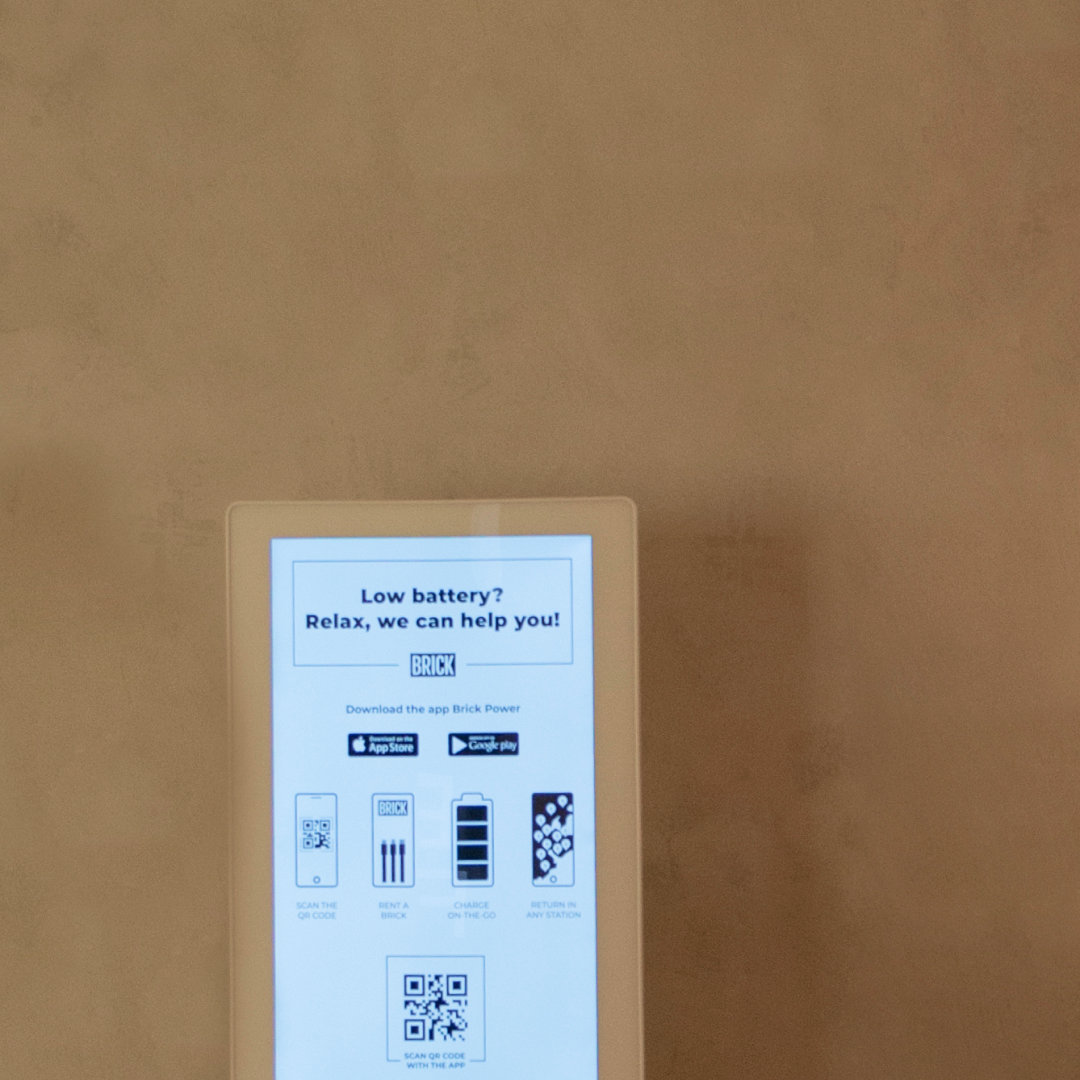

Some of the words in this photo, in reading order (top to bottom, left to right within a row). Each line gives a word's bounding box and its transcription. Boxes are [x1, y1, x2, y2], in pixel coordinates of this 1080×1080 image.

[361, 588, 406, 604] Low
[412, 587, 504, 607] battery?
[305, 612, 371, 632] Relax,
[377, 616, 410, 629] we
[415, 616, 454, 629] can
[461, 612, 508, 632] help
[514, 611, 560, 632] you!
[411, 653, 456, 677] BRICK
[346, 704, 403, 714] Download
[406, 704, 425, 714] the
[428, 706, 450, 716] app
[452, 703, 482, 714] Brick
[485, 703, 521, 714] Power
[368, 742, 389, 755] App
[389, 742, 415, 754] Store
[468, 739, 499, 753] Google
[378, 800, 408, 816] BRICK
[296, 901, 320, 910] SCAN
[321, 901, 338, 910] THE
[378, 901, 401, 910] RENT
[402, 901, 410, 910] A
[453, 901, 490, 910] CHARGE
[530, 901, 566, 909] RETURN
[567, 901, 577, 909] IN
[297, 911, 311, 920] QR
[312, 911, 337, 920] CODE
[380, 911, 407, 920] BRICK
[526, 911, 544, 919] ANY
[545, 911, 582, 919] STATION
[403, 1051, 427, 1060] SCAN
[428, 1051, 441, 1061] QR
[442, 1051, 466, 1060] CODE
[406, 1061, 429, 1070] WITH
[430, 1061, 446, 1070] THE
[448, 1061, 466, 1070] APP
